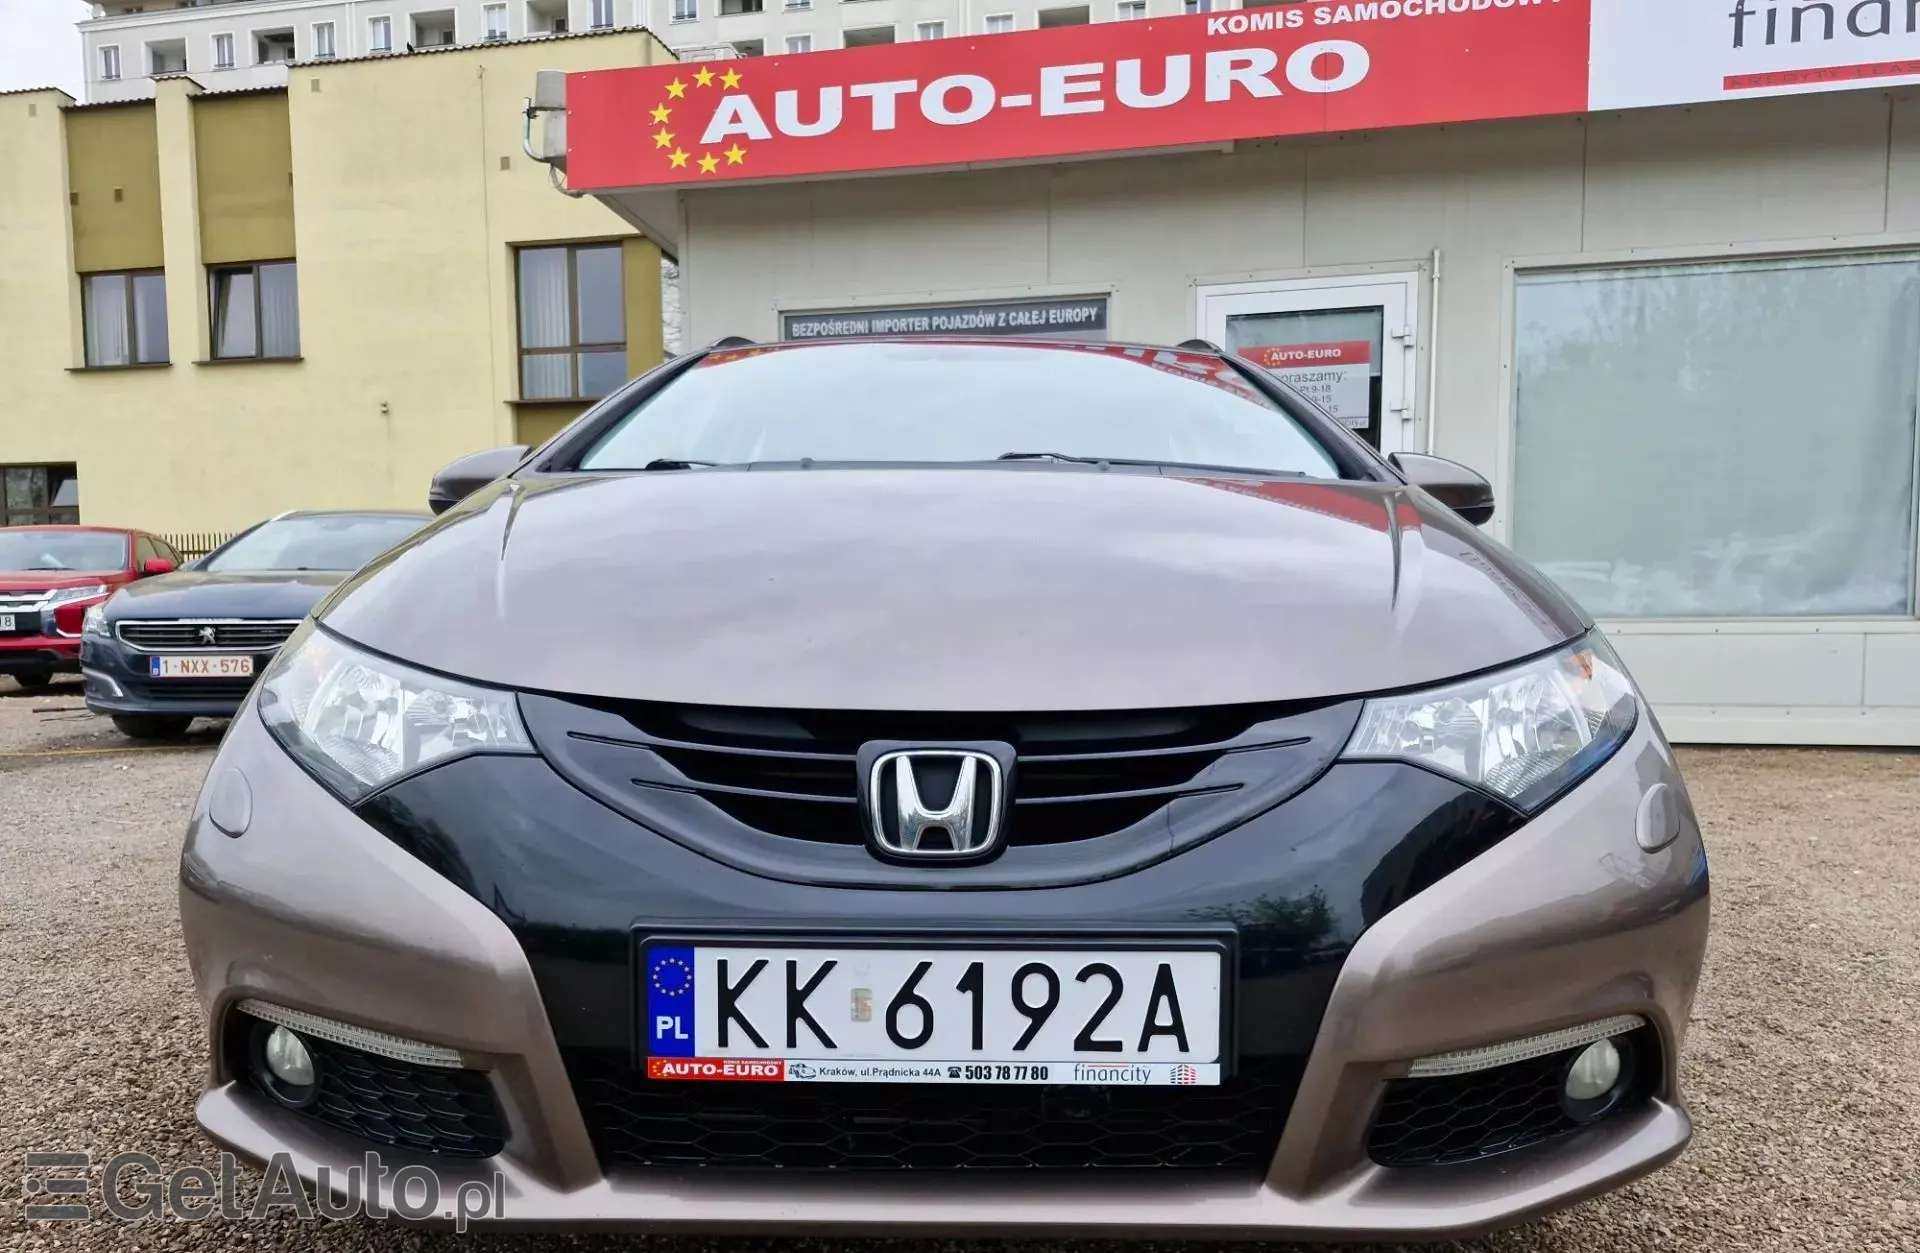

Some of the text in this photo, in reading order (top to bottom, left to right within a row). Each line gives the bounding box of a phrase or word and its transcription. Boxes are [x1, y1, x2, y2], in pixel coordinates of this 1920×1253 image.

[1207, 0, 1561, 35] KOMIS SAMOCHOD
[700, 39, 1370, 144] AUTO-EURO
[792, 306, 1098, 337] BEZPOŚREDNI IMPORTER POJAZDÓW Z CAŁEJ EUROPY
[1271, 348, 1341, 361] AUTO-EURO
[717, 959, 1190, 1053] KK 6192A
[656, 1016, 689, 1040] PL
[662, 1063, 778, 1076] AUTO-EURO
[819, 1067, 858, 1077] Kraków,
[922, 1068, 942, 1077] 44A
[965, 1065, 992, 1080] 503
[995, 1065, 1011, 1080] 78
[1013, 1065, 1028, 1080] 77
[1030, 1065, 1049, 1080] 80
[1074, 1063, 1151, 1085] financity
